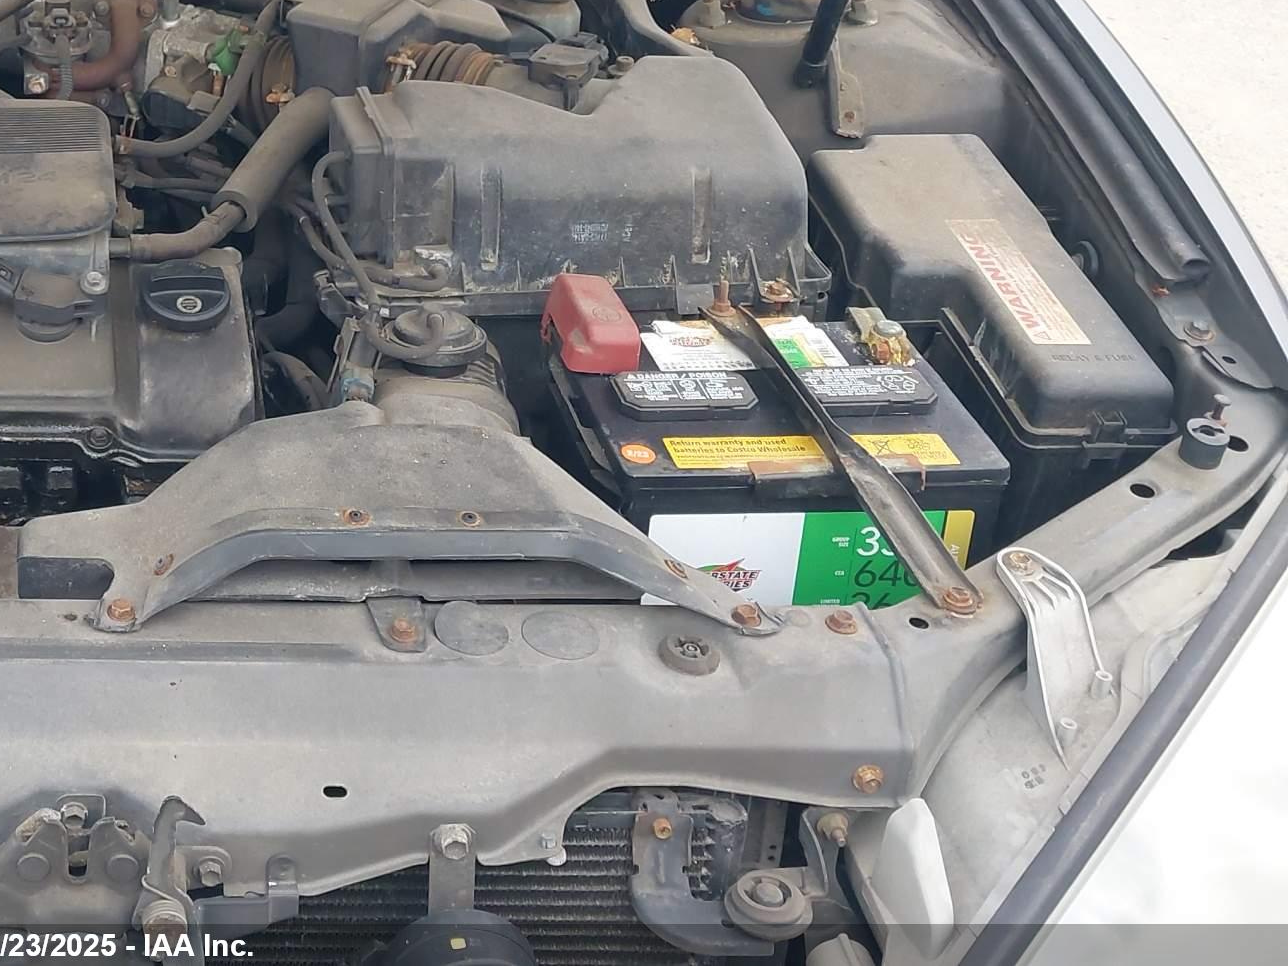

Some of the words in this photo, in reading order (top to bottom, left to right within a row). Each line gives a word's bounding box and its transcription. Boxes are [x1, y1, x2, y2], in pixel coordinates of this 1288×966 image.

[961, 234, 1042, 330] WARNING
[637, 372, 680, 380] DANGER
[688, 371, 728, 379] POISON
[669, 439, 701, 447] Return
[764, 438, 787, 446] used
[673, 446, 714, 454] batteries
[727, 445, 756, 453] Costco
[758, 445, 806, 453] Wholesale
[857, 526, 895, 556] 3
[712, 570, 758, 580] RSTATE
